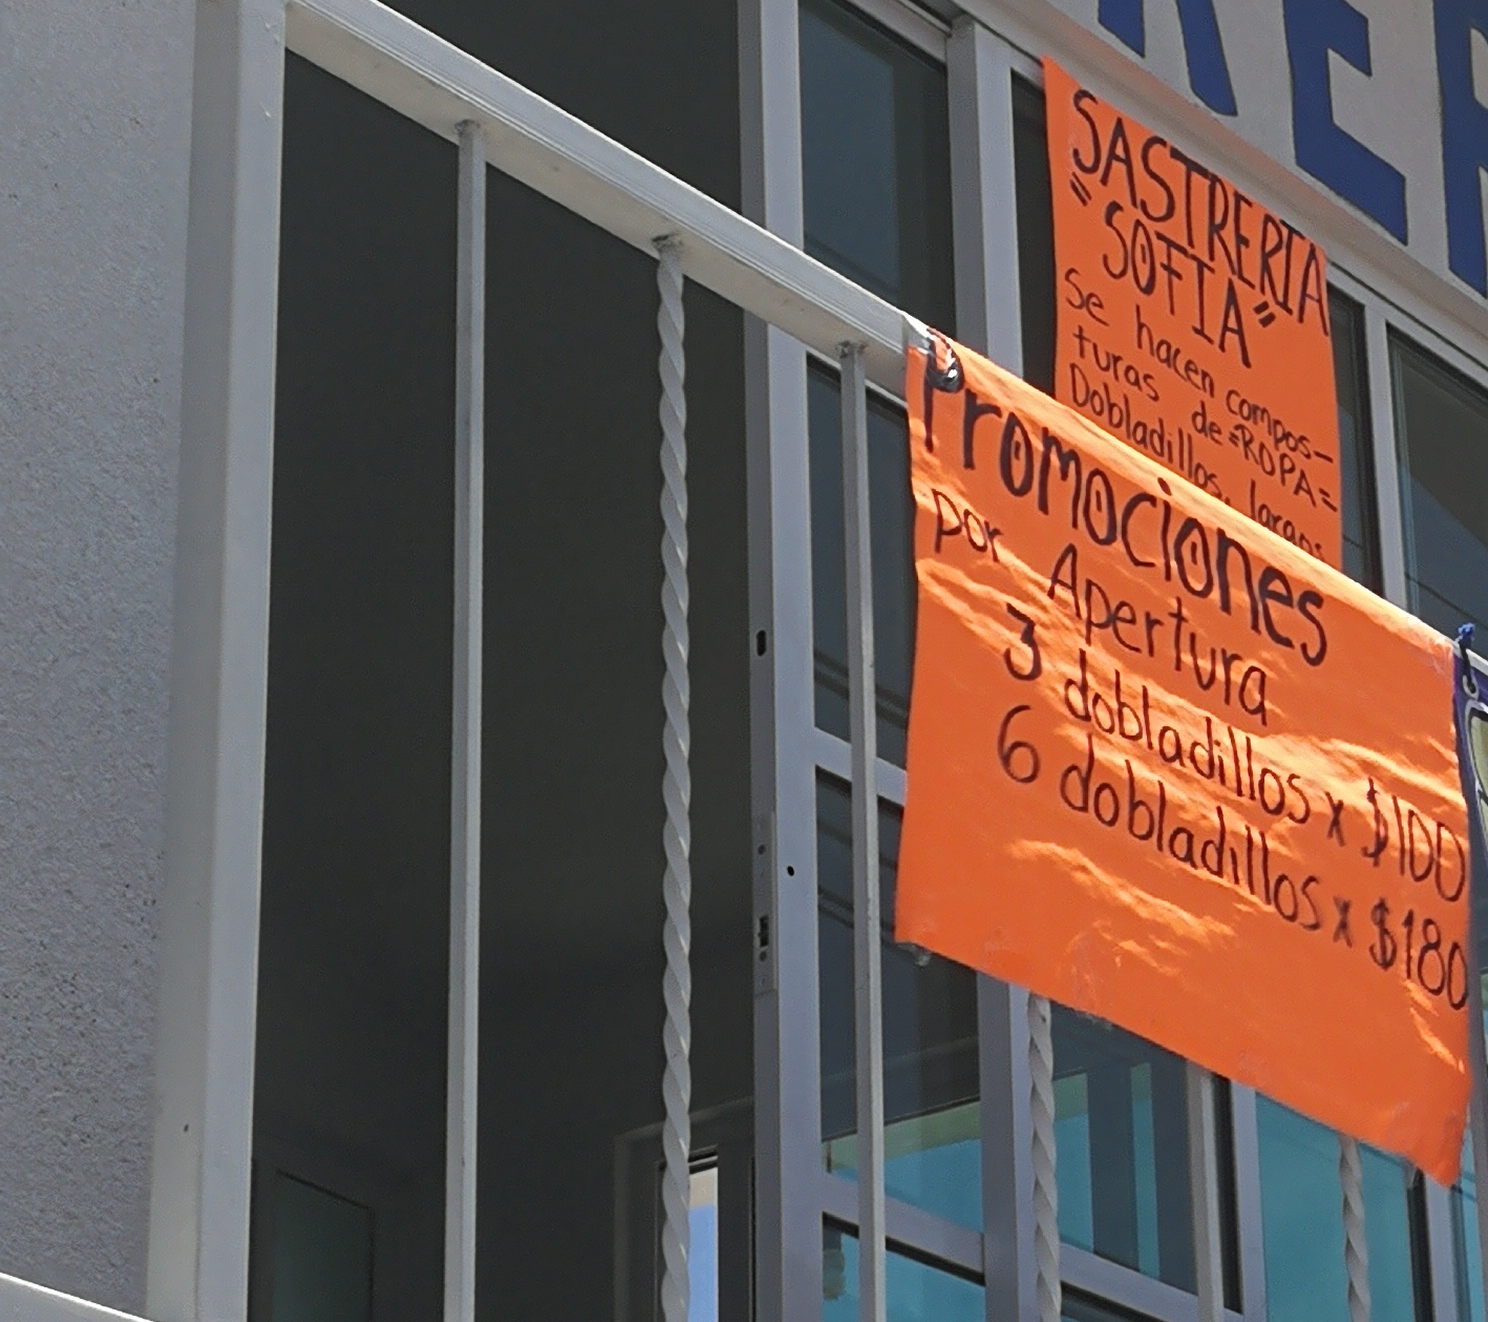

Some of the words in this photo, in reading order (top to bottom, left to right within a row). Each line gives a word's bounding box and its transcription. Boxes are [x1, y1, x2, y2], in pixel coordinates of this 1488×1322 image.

[1064, 267, 1110, 327] Se
[1135, 303, 1215, 398] hacen
[1070, 88, 1330, 337] SASTRERIA
[1072, 324, 1160, 402] turas
[1191, 399, 1223, 445] de
[931, 488, 1003, 563] por
[1046, 544, 1268, 727] Apertura
[996, 704, 1040, 783] 6
[1059, 733, 1321, 933] dobladillos
[1369, 897, 1470, 1011] $180
[1002, 603, 1042, 681] 3
[1063, 649, 1312, 825] dobladillos
[1361, 777, 1467, 903] $100
